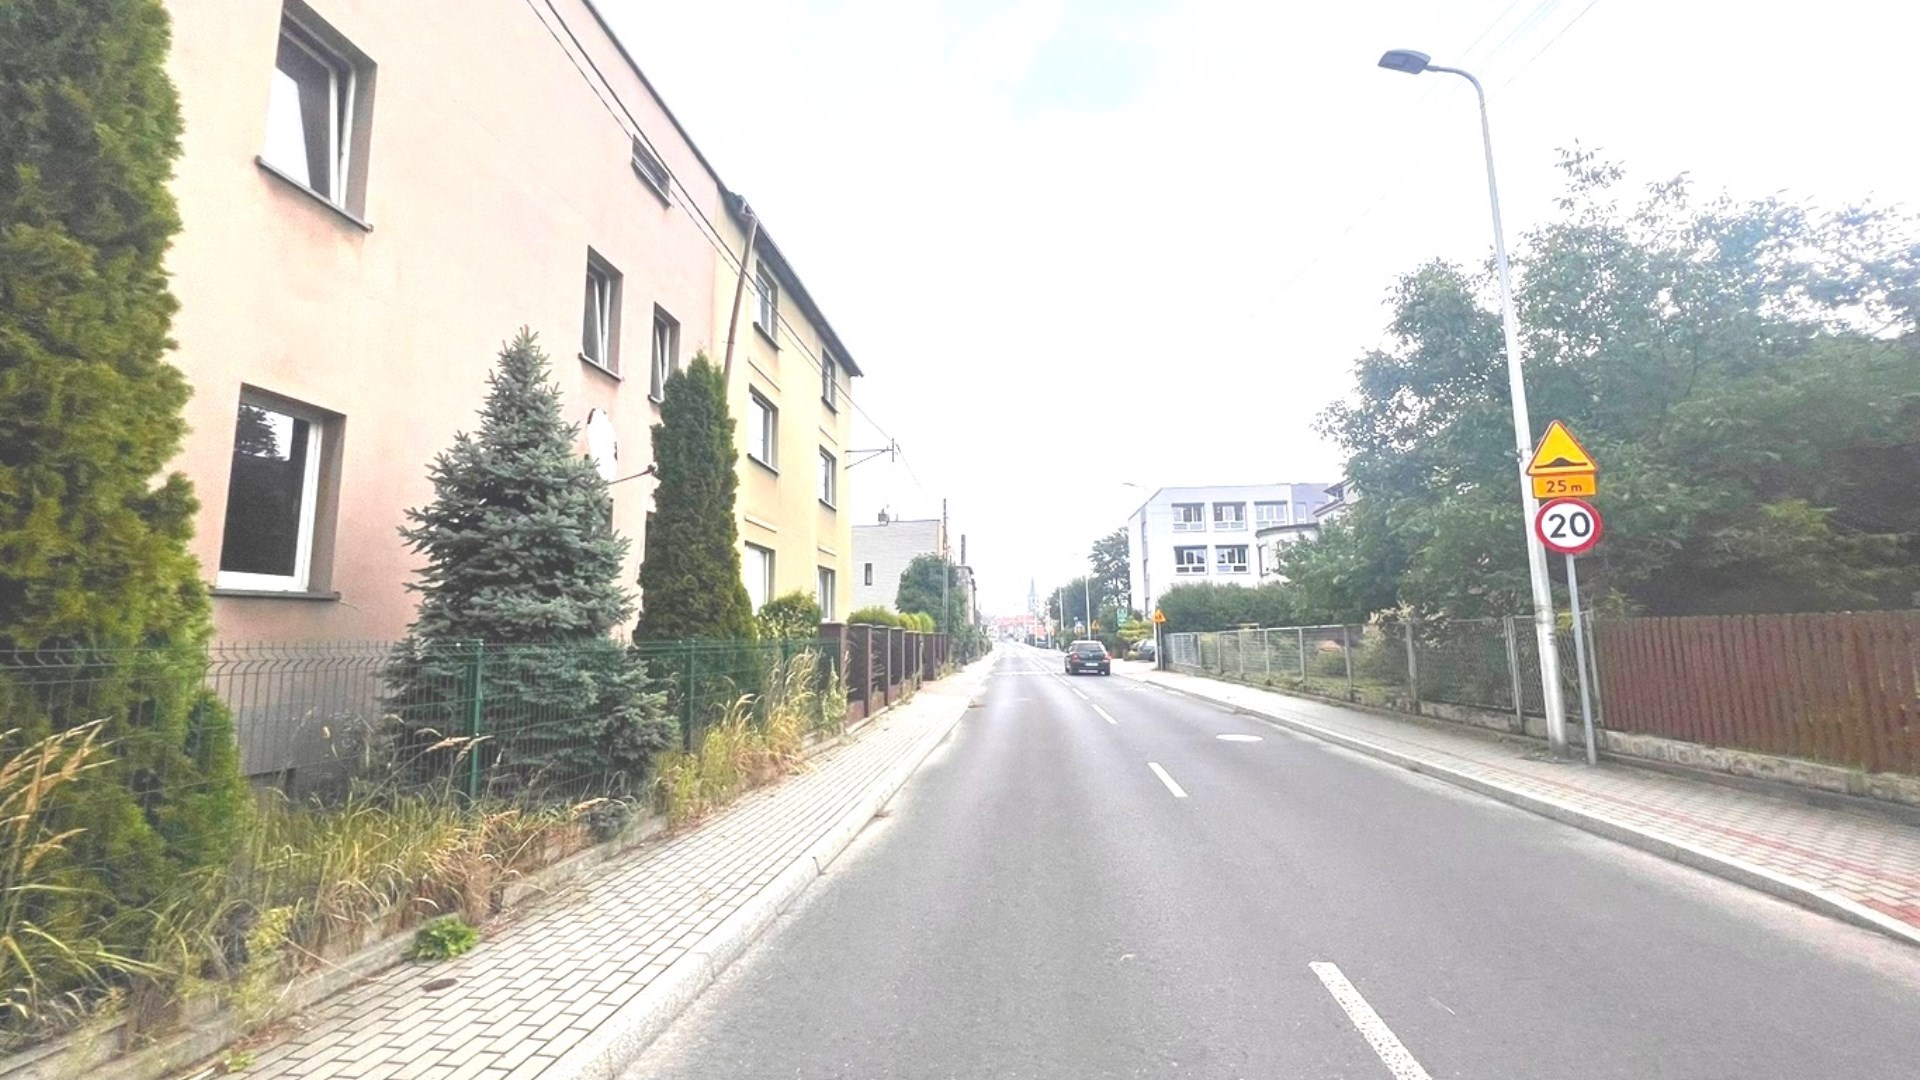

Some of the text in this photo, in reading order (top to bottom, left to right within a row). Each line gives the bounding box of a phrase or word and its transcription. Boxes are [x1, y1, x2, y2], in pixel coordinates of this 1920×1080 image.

[1546, 480, 1583, 493] 25 m
[1548, 511, 1590, 538] 20
